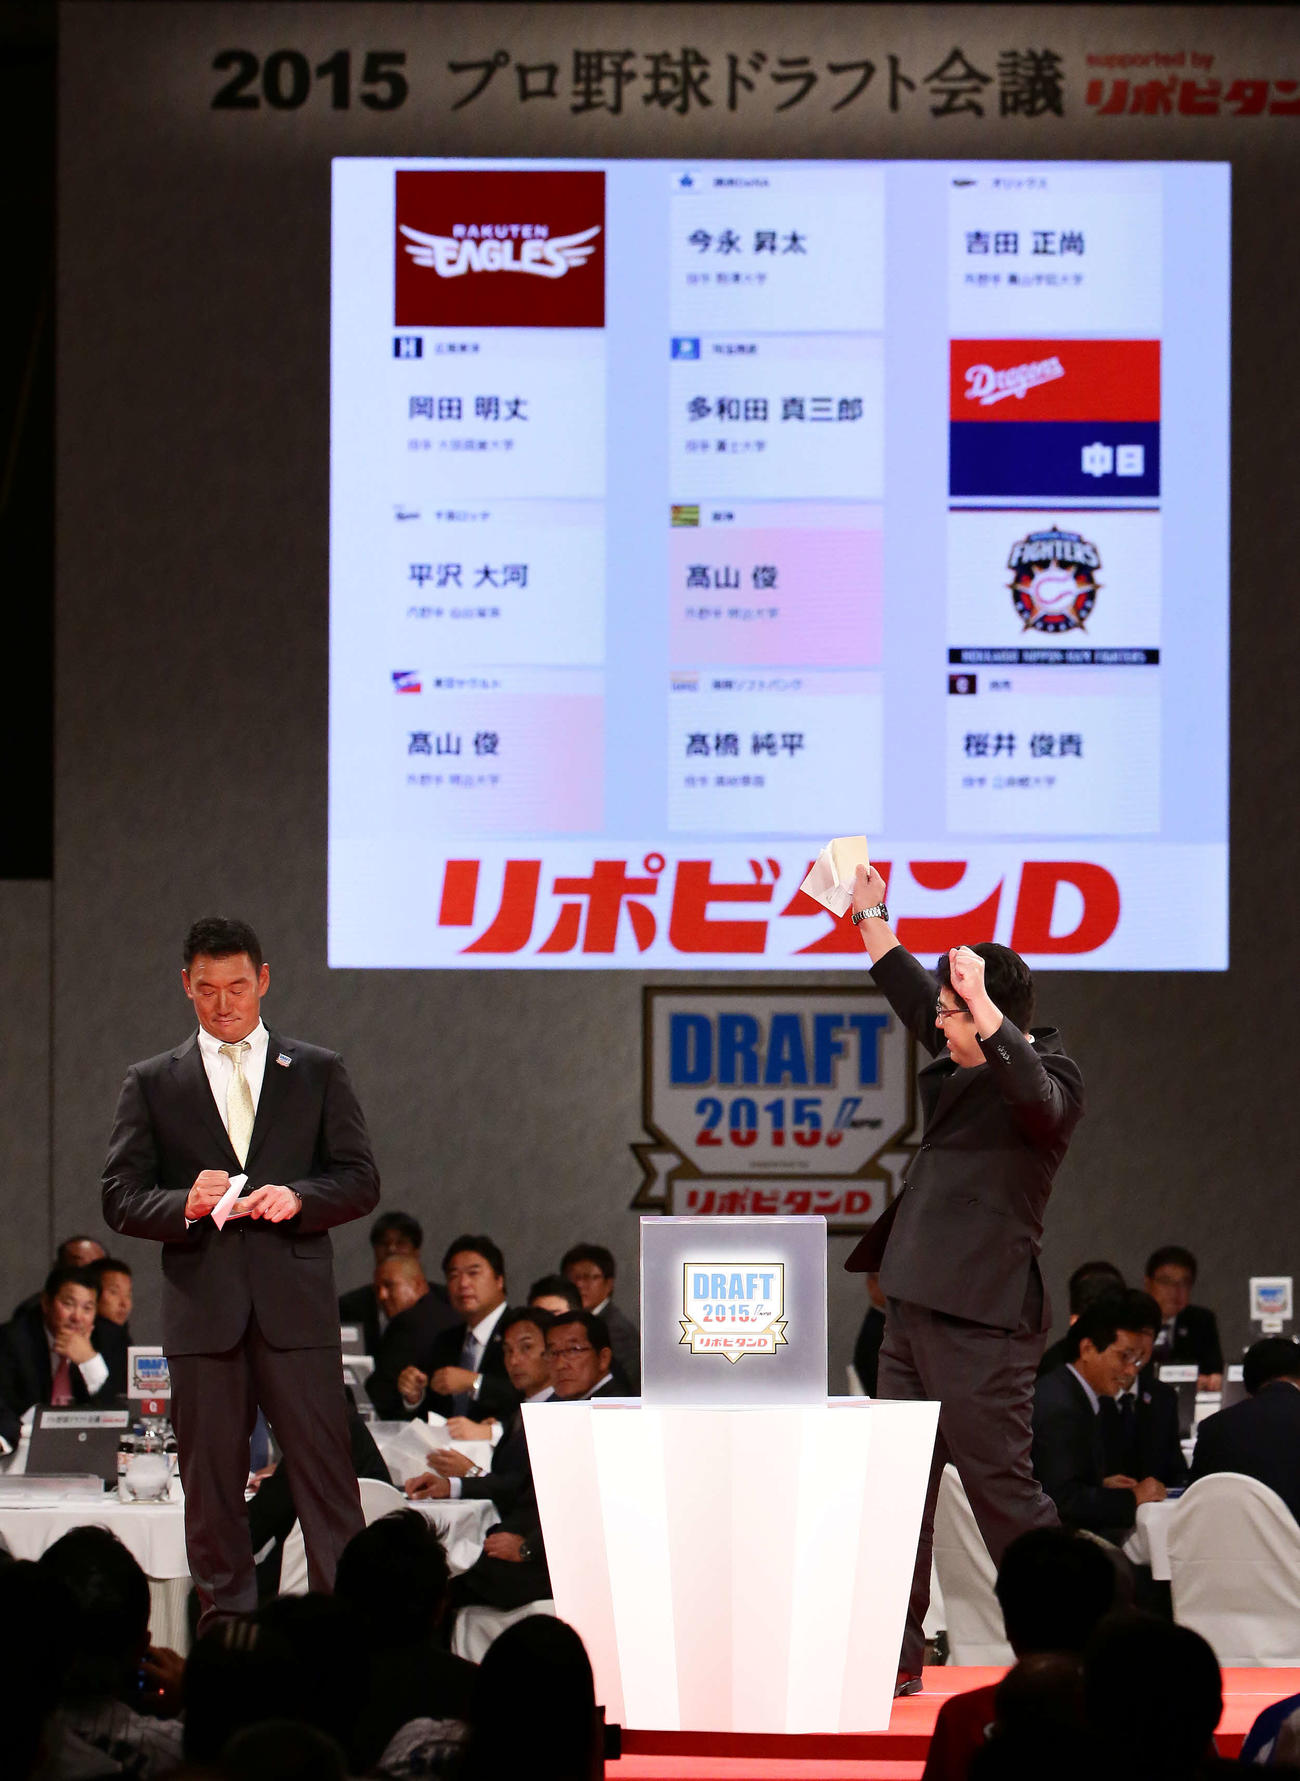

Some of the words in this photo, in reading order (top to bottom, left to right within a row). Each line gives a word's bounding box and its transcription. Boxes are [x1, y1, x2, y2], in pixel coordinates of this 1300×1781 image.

[211, 49, 408, 110] 2015
[448, 46, 1065, 117] プロ野球ドラフト会議
[452, 224, 549, 239] RAKUTEN
[688, 228, 741, 254] 今永
[966, 231, 1018, 255] 吉田
[1031, 231, 1085, 255] 正尚
[432, 238, 570, 279] EAGLES
[964, 356, 1065, 406] Dragons
[409, 396, 462, 420] 岡田
[687, 396, 768, 422] 多和田
[1080, 442, 1145, 477] 中日
[669, 1012, 889, 1086] DRAFT
[693, 1273, 774, 1300] DRAFT
